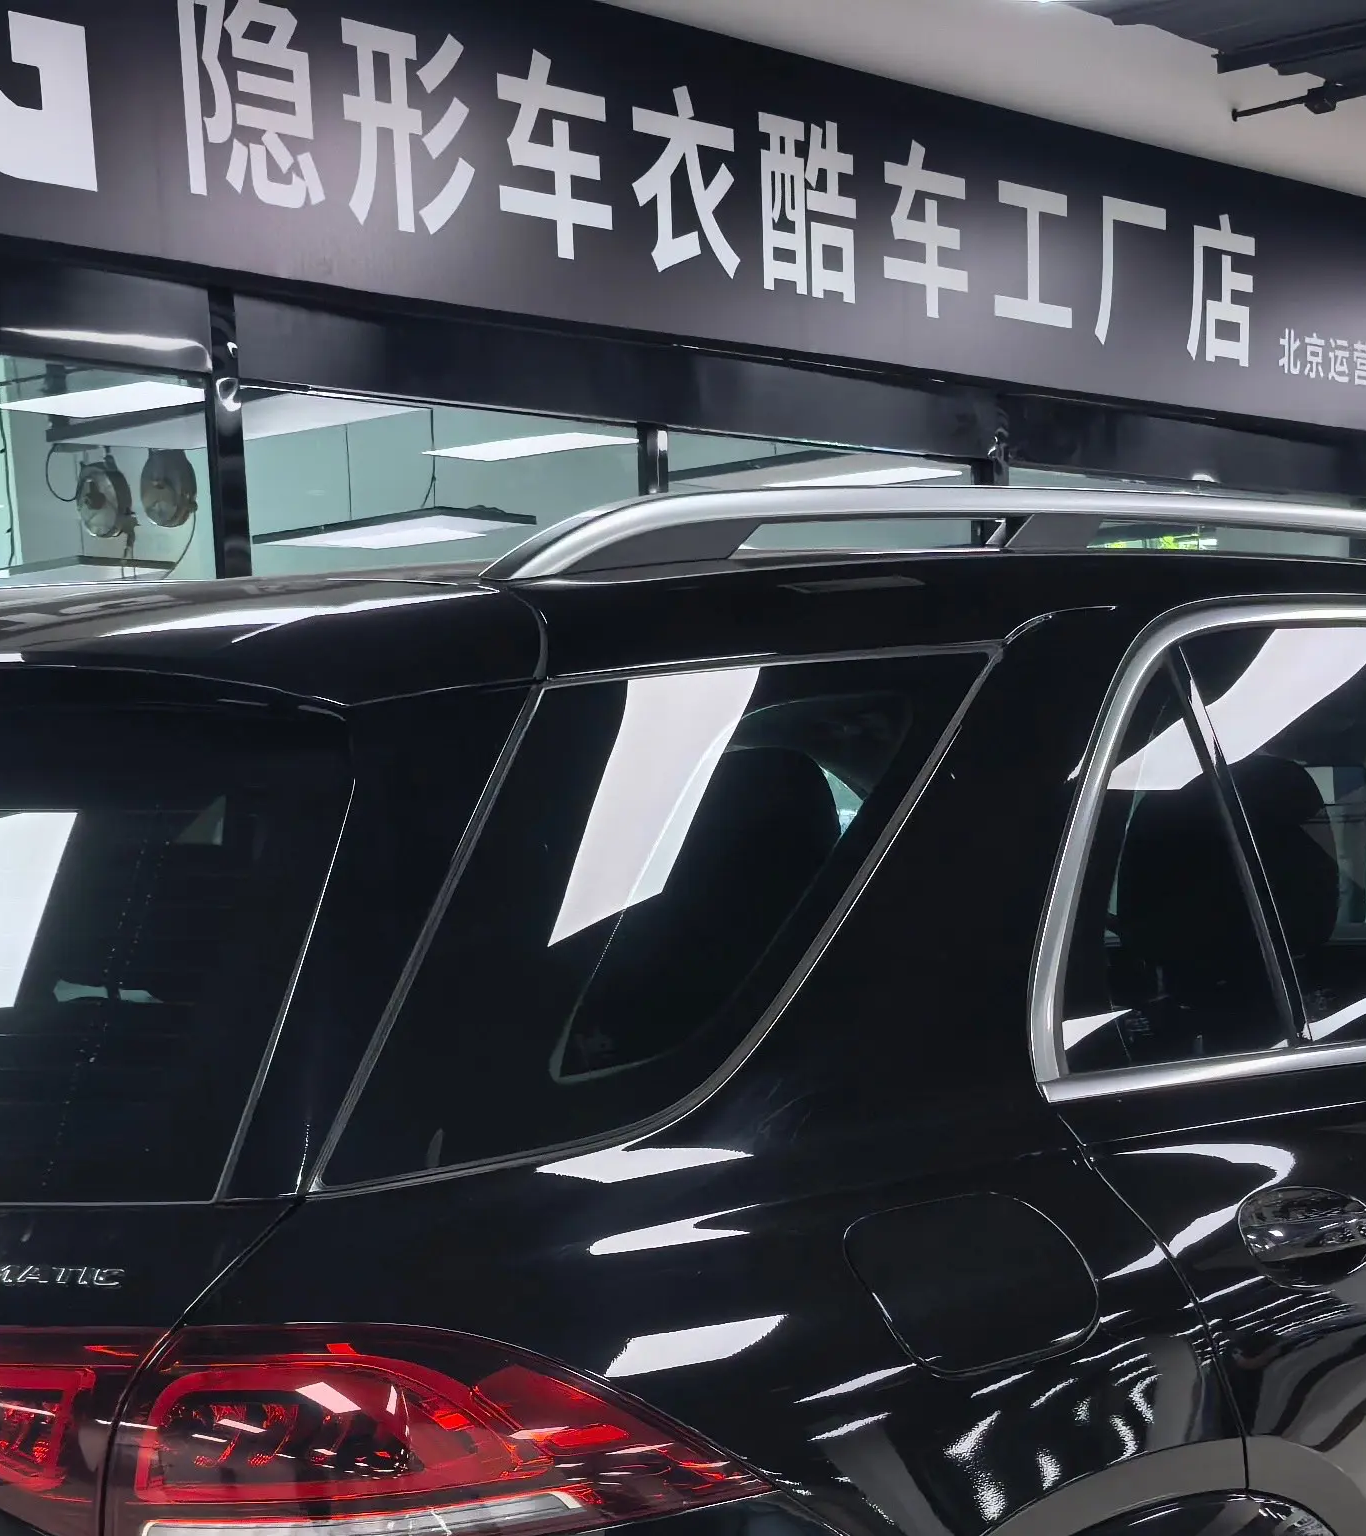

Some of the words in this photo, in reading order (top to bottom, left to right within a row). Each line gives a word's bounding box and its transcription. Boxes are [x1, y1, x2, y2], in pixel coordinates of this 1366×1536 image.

[177, 0, 1257, 368] 隐形车衣酷车工厂店
